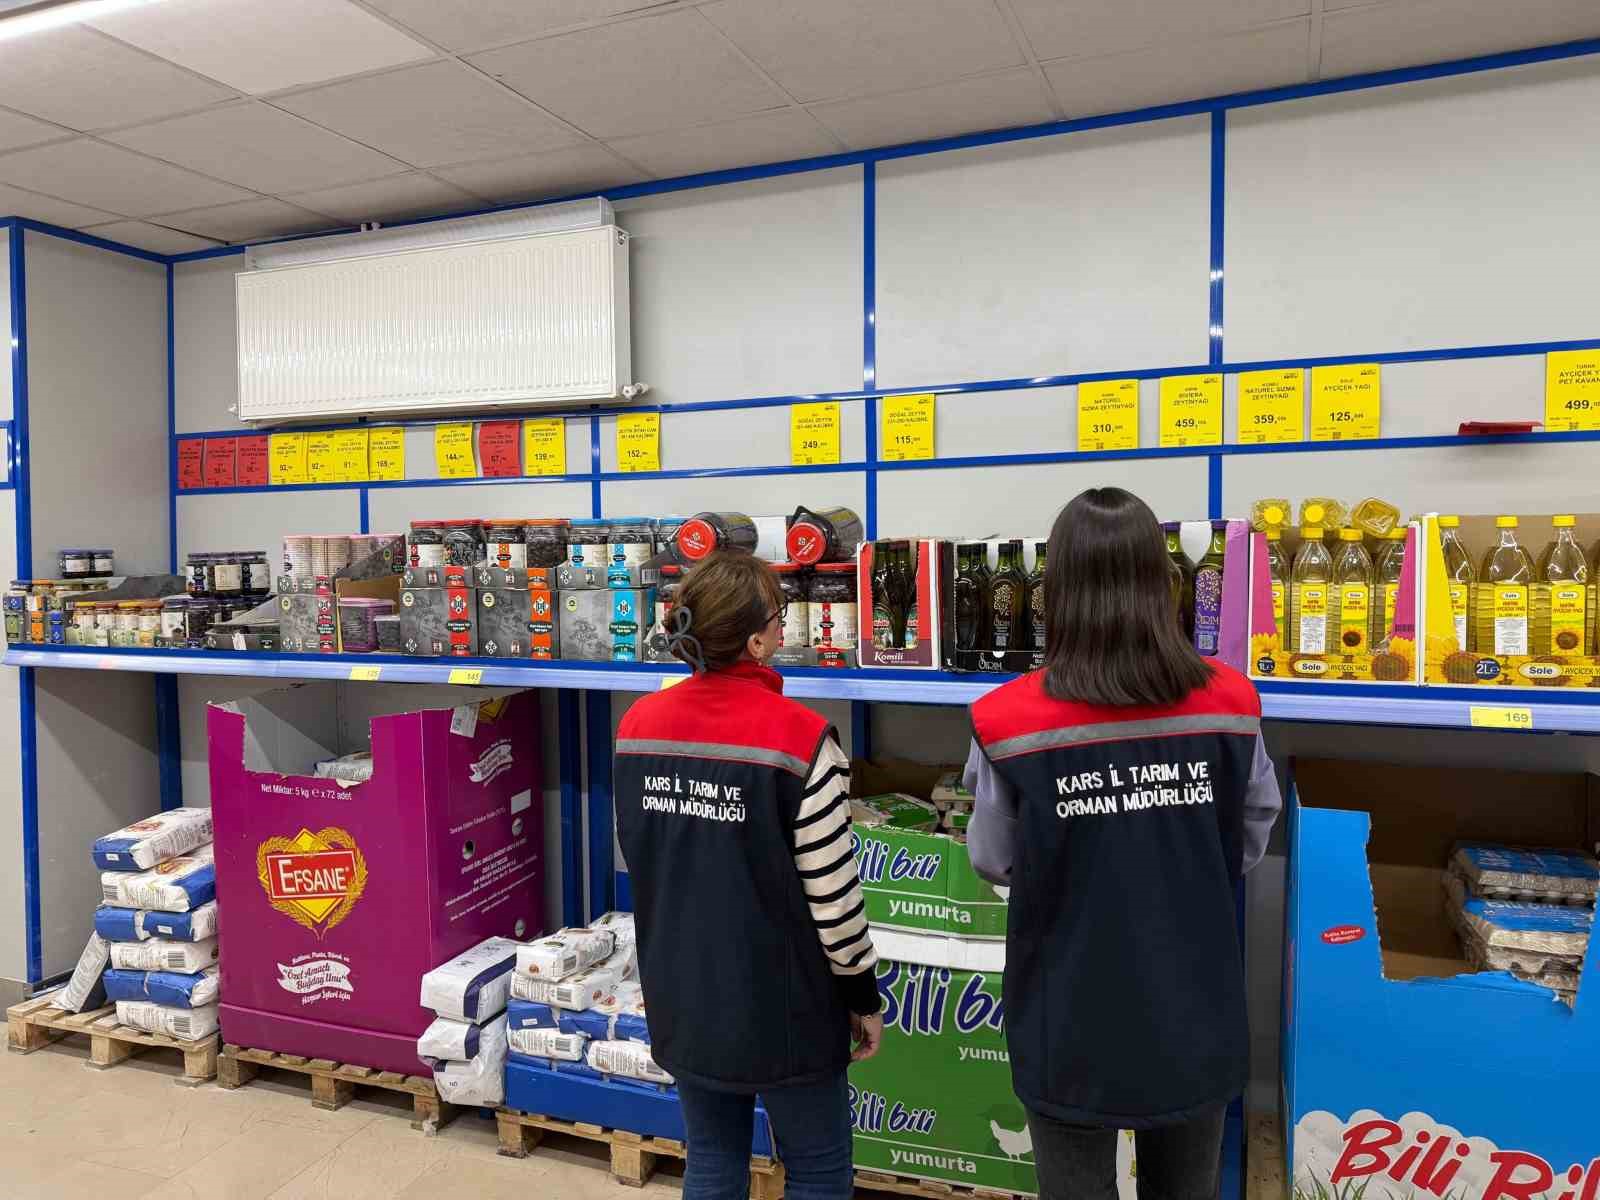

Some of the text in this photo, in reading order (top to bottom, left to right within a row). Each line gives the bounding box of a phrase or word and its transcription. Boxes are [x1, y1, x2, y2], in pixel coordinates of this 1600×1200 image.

[1575, 377, 1600, 385] KAVAN
[874, 650, 905, 665] Komili
[1302, 662, 1322, 671] Sole
[1528, 666, 1554, 676] Sole
[644, 775, 672, 792] KARS
[688, 779, 719, 800] TARIM
[723, 785, 743, 802] VE
[1055, 771, 1104, 795] KARS
[1128, 762, 1181, 785] TARIM
[1186, 761, 1210, 780] VE
[642, 795, 746, 822] ORMAN MÜDÜRLÜĞÜ
[1055, 780, 1215, 819] ORMAN MÜDÜRLÜĞÜ
[277, 858, 350, 895] EFSANE
[888, 898, 973, 928] yumurta
[958, 1045, 1010, 1064] yumu
[887, 1100, 938, 1136] bili
[889, 1147, 978, 1176] yumurta
[1329, 1117, 1471, 1199] Bili
